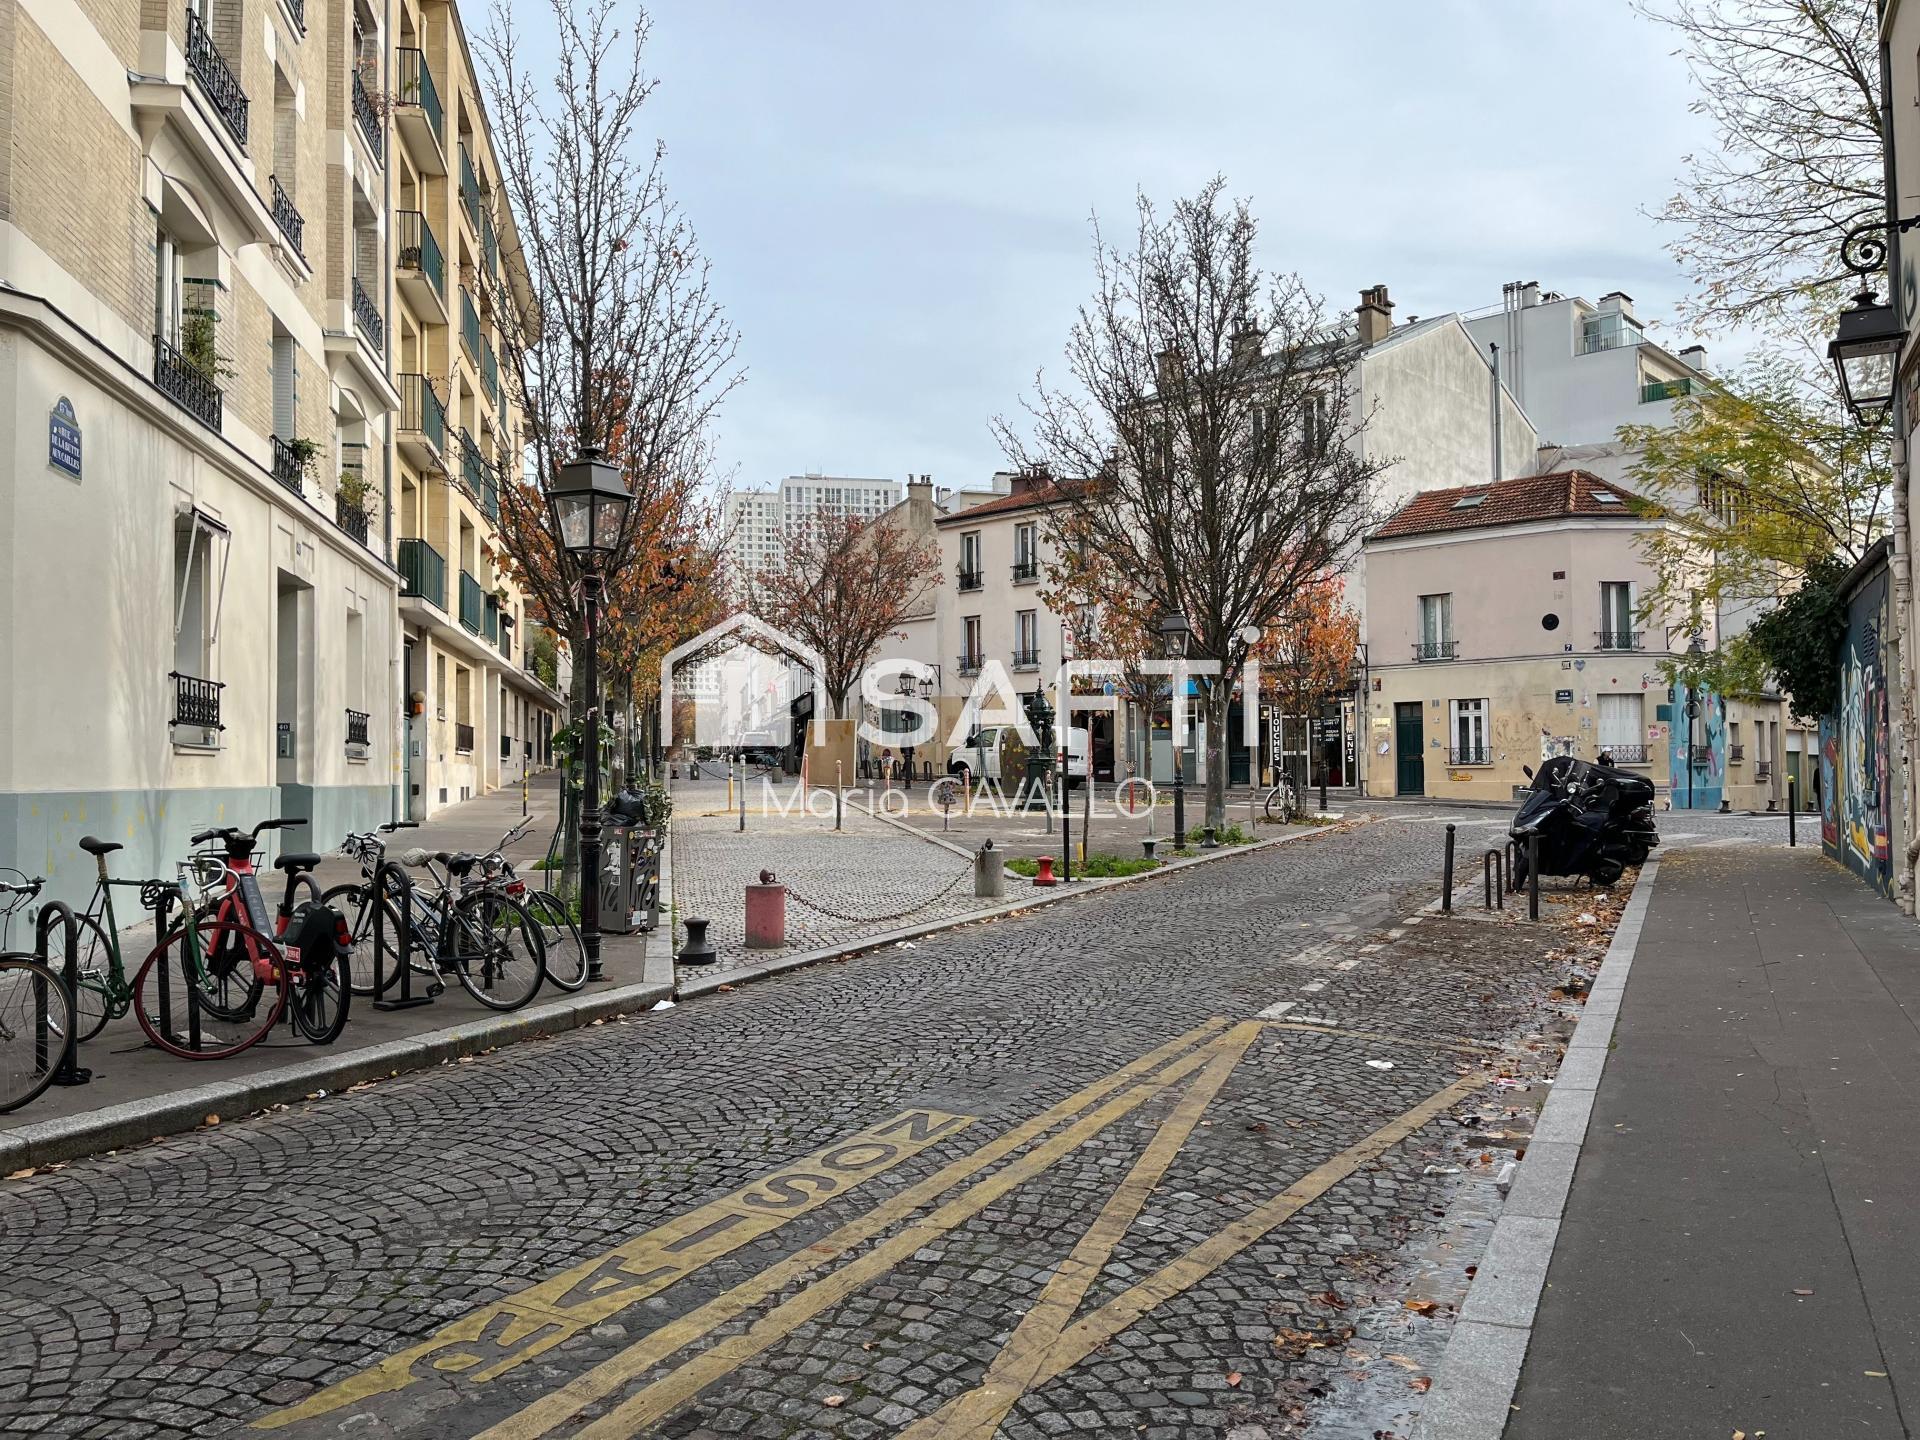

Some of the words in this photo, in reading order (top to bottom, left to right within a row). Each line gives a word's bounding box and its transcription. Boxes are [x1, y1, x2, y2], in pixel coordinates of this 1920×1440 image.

[58, 437, 65, 449] LA
[65, 441, 80, 457] BUTTE
[61, 452, 80, 469] CAILLES
[1272, 705, 1280, 761] ETOUCHES
